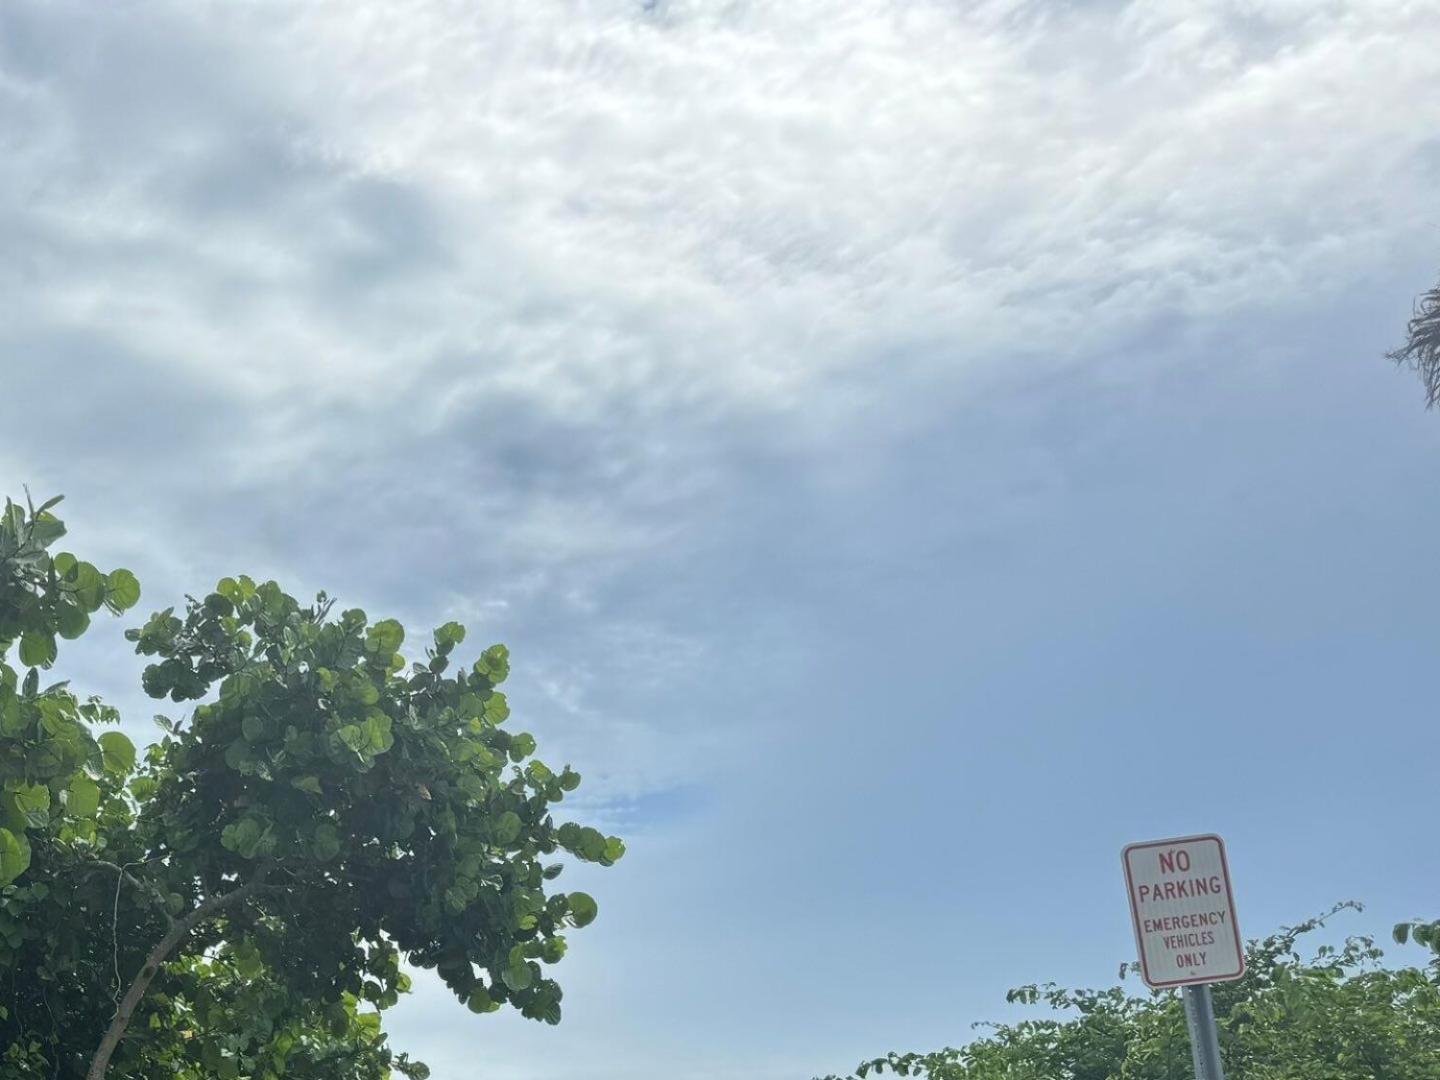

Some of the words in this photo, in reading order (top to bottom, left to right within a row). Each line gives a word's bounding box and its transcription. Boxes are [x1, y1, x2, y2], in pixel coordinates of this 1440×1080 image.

[1159, 850, 1190, 874] NO
[1138, 876, 1222, 903] PARKING
[1143, 911, 1226, 933] EMERGENCY
[1163, 931, 1215, 950] VEHICLES
[1176, 952, 1207, 968] ONLY
